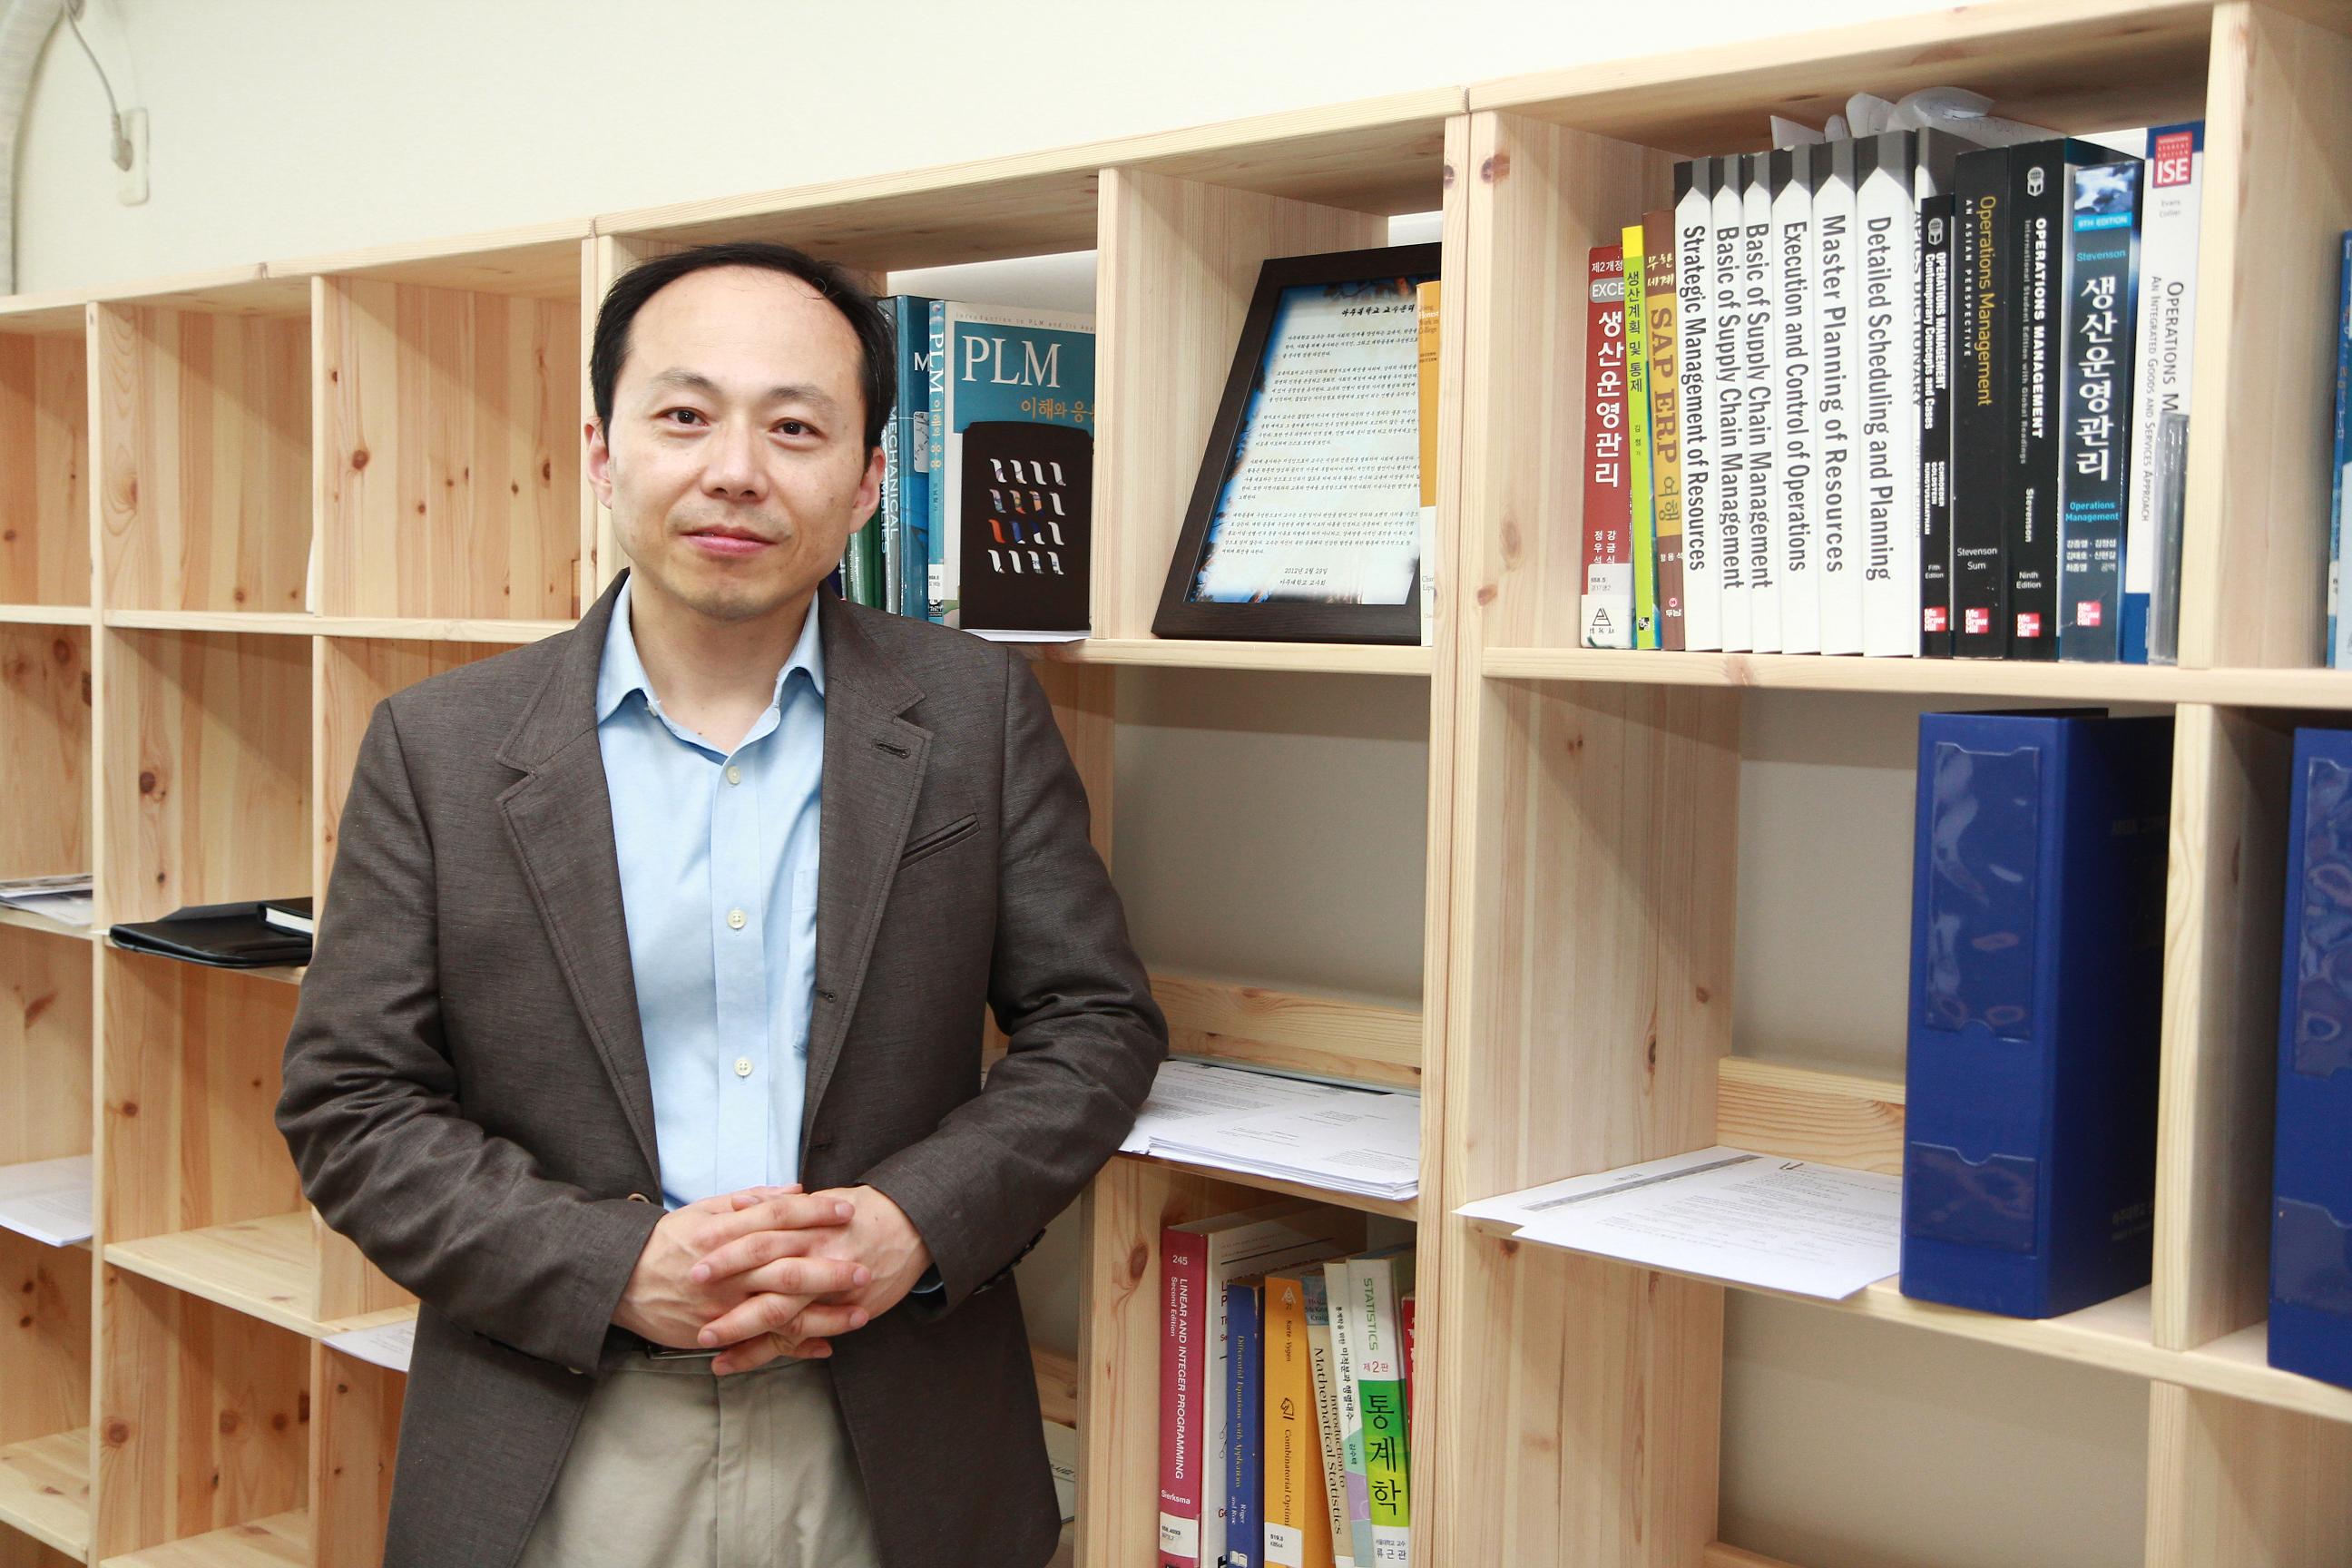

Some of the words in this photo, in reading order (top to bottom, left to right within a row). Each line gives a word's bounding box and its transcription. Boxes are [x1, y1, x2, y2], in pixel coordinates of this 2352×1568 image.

[2157, 158, 2188, 184] ISE
[1965, 199, 1973, 215] AN
[2096, 215, 2128, 226] EDITION
[1591, 260, 1623, 273] 제2개정
[1716, 226, 1740, 284] Basic
[1746, 223, 1769, 281] Basic
[1822, 214, 1846, 299] Master
[1867, 217, 1891, 309] Detailed
[1965, 222, 1973, 261] ASIAN
[1975, 196, 1996, 289] Operations
[2023, 219, 2032, 283] International
[2075, 250, 2126, 261] Stevenson
[1680, 226, 1706, 313] Strategic
[1784, 221, 1808, 318] Execution
[1924, 253, 1936, 326] Contemporary
[1936, 251, 1946, 316] OPERATIONS
[2034, 218, 2047, 321] OPERATIONS
[1341, 305, 1379, 317] 아주대학교
[1627, 270, 1641, 334] 생산계획
[1718, 289, 1741, 309] of
[1747, 287, 1770, 306] of
[1964, 269, 1972, 357] PERSPECTIVE
[1629, 341, 1641, 356] 및
[1651, 307, 1673, 378] SAP
[1715, 315, 1741, 382] Supply
[1746, 311, 1770, 380] Supply
[1785, 323, 1808, 358] and
[1819, 307, 1847, 413] Planning
[1924, 328, 1935, 376] Concepts
[1935, 317, 1946, 389] MANAGEMENT
[1975, 292, 1995, 407] Management
[2022, 324, 2030, 360] Edition
[2162, 282, 2184, 385] OPERATIONS
[929, 332, 944, 395] PLM
[961, 335, 1062, 388] PLM
[1630, 364, 1642, 392] 통제
[1681, 318, 1707, 445] Management
[1864, 313, 1892, 436] Scheduling
[1925, 377, 1935, 397] and
[2032, 326, 2046, 439] MANAGEMENT
[2075, 275, 2118, 482] 생산운영관리
[931, 399, 942, 436] 이해와
[1020, 397, 1068, 421] 이해와
[1070, 400, 1095, 423] 응
[1595, 310, 1624, 488] 생산운영관리
[1720, 387, 1742, 447] Chain
[1749, 386, 1771, 446] Chain
[1786, 364, 1809, 435] Control
[1925, 397, 1935, 430] Cases
[1654, 390, 1677, 464] ERP
[1787, 441, 1810, 458] of
[1825, 419, 1847, 440] of
[888, 406, 898, 540] MECHANICAL
[930, 442, 942, 471] 응용
[1687, 448, 1709, 466] of
[1869, 441, 1893, 479] and
[1658, 476, 1681, 522] 여행
[1688, 471, 1709, 571] Resources
[1719, 453, 1744, 589] Management
[1749, 451, 1773, 589] Management
[1783, 464, 1811, 572] Operations
[1825, 449, 1847, 573] Resources
[2025, 488, 2034, 543] Stevenson
[2065, 512, 2119, 523] Management
[2070, 501, 2115, 512] Operations
[1593, 530, 1603, 564] 정우석
[1606, 530, 1616, 564] 강금식
[1866, 485, 1894, 581] Planning
[1957, 547, 1997, 557] Stevenson
[1967, 561, 1986, 570] Sum
[2015, 580, 2042, 590] Edition
[2019, 571, 2038, 580] Ninth
[1172, 1255, 1188, 1266] 245
[1179, 1278, 1188, 1317] LINEAR
[1363, 1278, 1378, 1351] STATISTICS
[1178, 1319, 1187, 1344] AND
[1237, 1335, 1245, 1380] Differential
[1177, 1346, 1187, 1392] INTEGER
[1340, 1348, 1351, 1382] 미적분과
[1363, 1361, 1389, 1373] 제2판
[1235, 1381, 1244, 1419] Equations
[1342, 1386, 1355, 1421] 행렬대수
[1175, 1394, 1186, 1480] PROGRAMMING
[1284, 1429, 1292, 1494] Combinatorial
[1314, 1348, 1336, 1457] Mathematical
[1326, 1463, 1342, 1535] Statistics
[1330, 1395, 1343, 1468] Introduction
[1337, 1473, 1346, 1488] to
[1365, 1395, 1402, 1516] 통계학
[1234, 1443, 1243, 1488] Applications
[1161, 1489, 1191, 1505] Sierksma
[1377, 1547, 1406, 1561] 류근관
